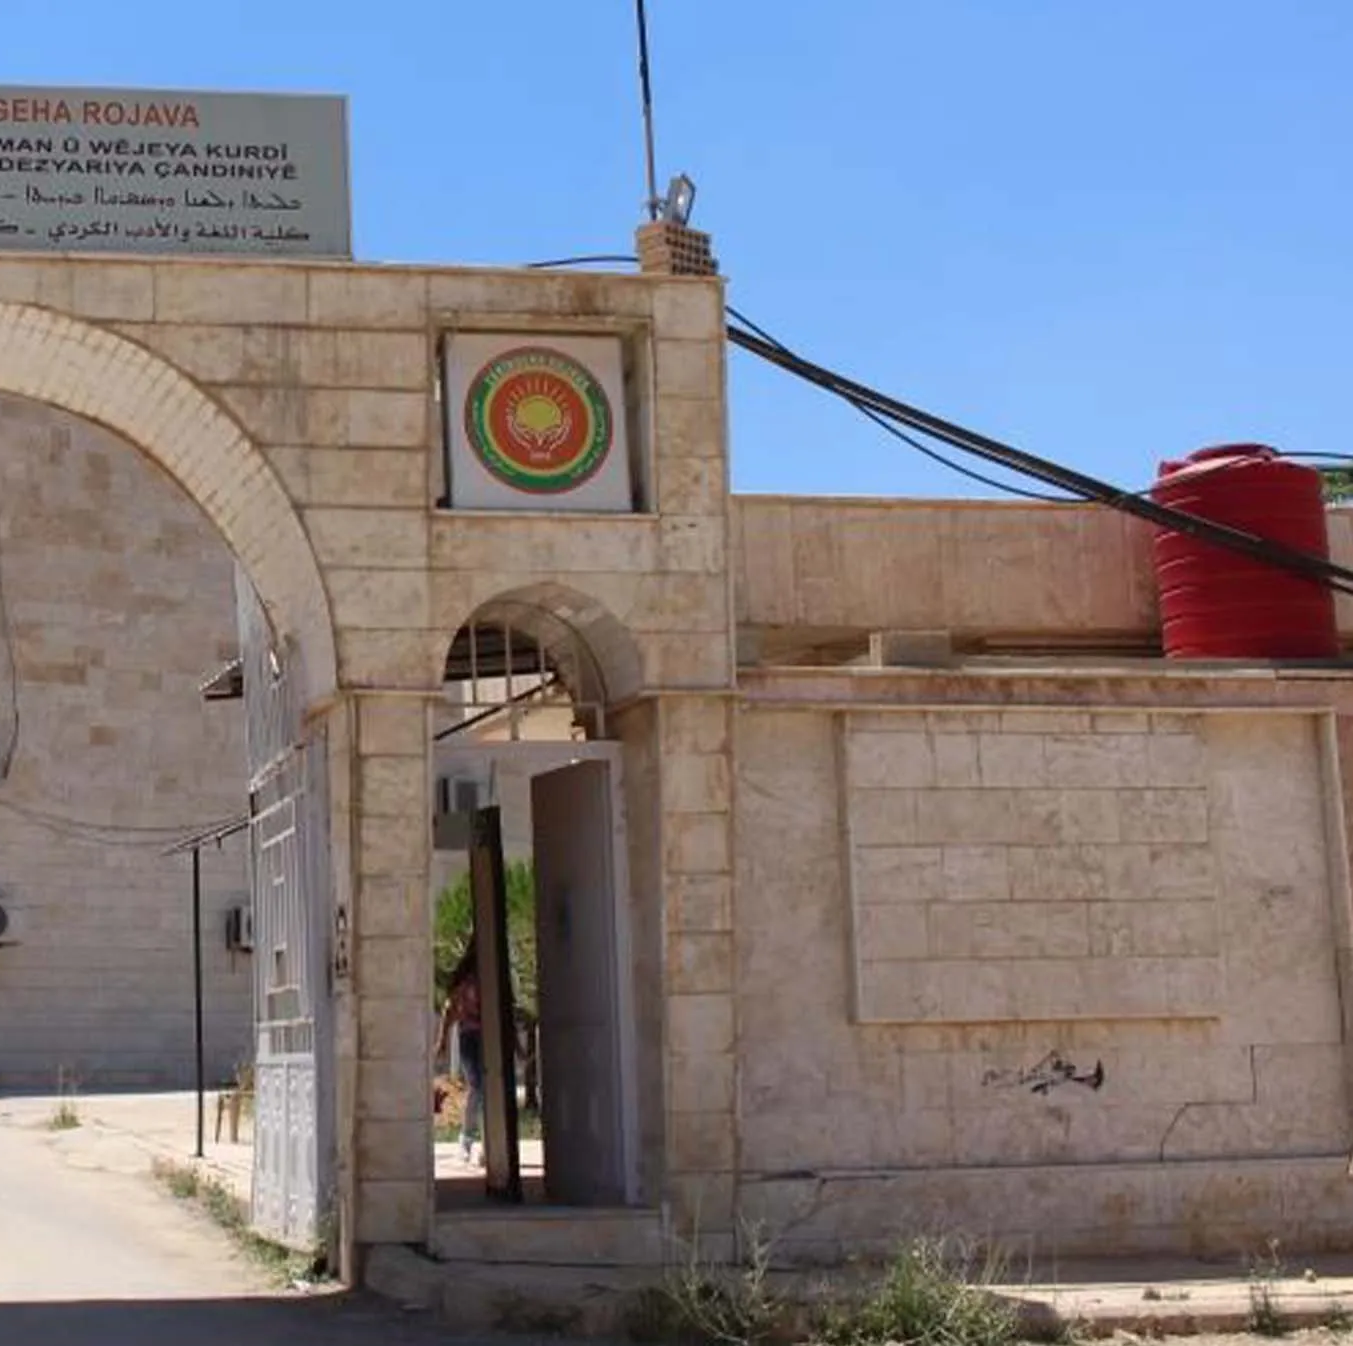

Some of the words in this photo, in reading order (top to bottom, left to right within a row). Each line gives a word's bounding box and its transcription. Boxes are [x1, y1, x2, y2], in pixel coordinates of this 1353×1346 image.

[83, 100, 200, 128] ROJAVA
[63, 136, 80, 154] Û
[88, 137, 198, 157] WÊJEYA
[206, 142, 288, 161] KURDÎ
[48, 221, 119, 243] الكردي
[197, 219, 248, 240] اللغة
[254, 224, 310, 246] كلية
